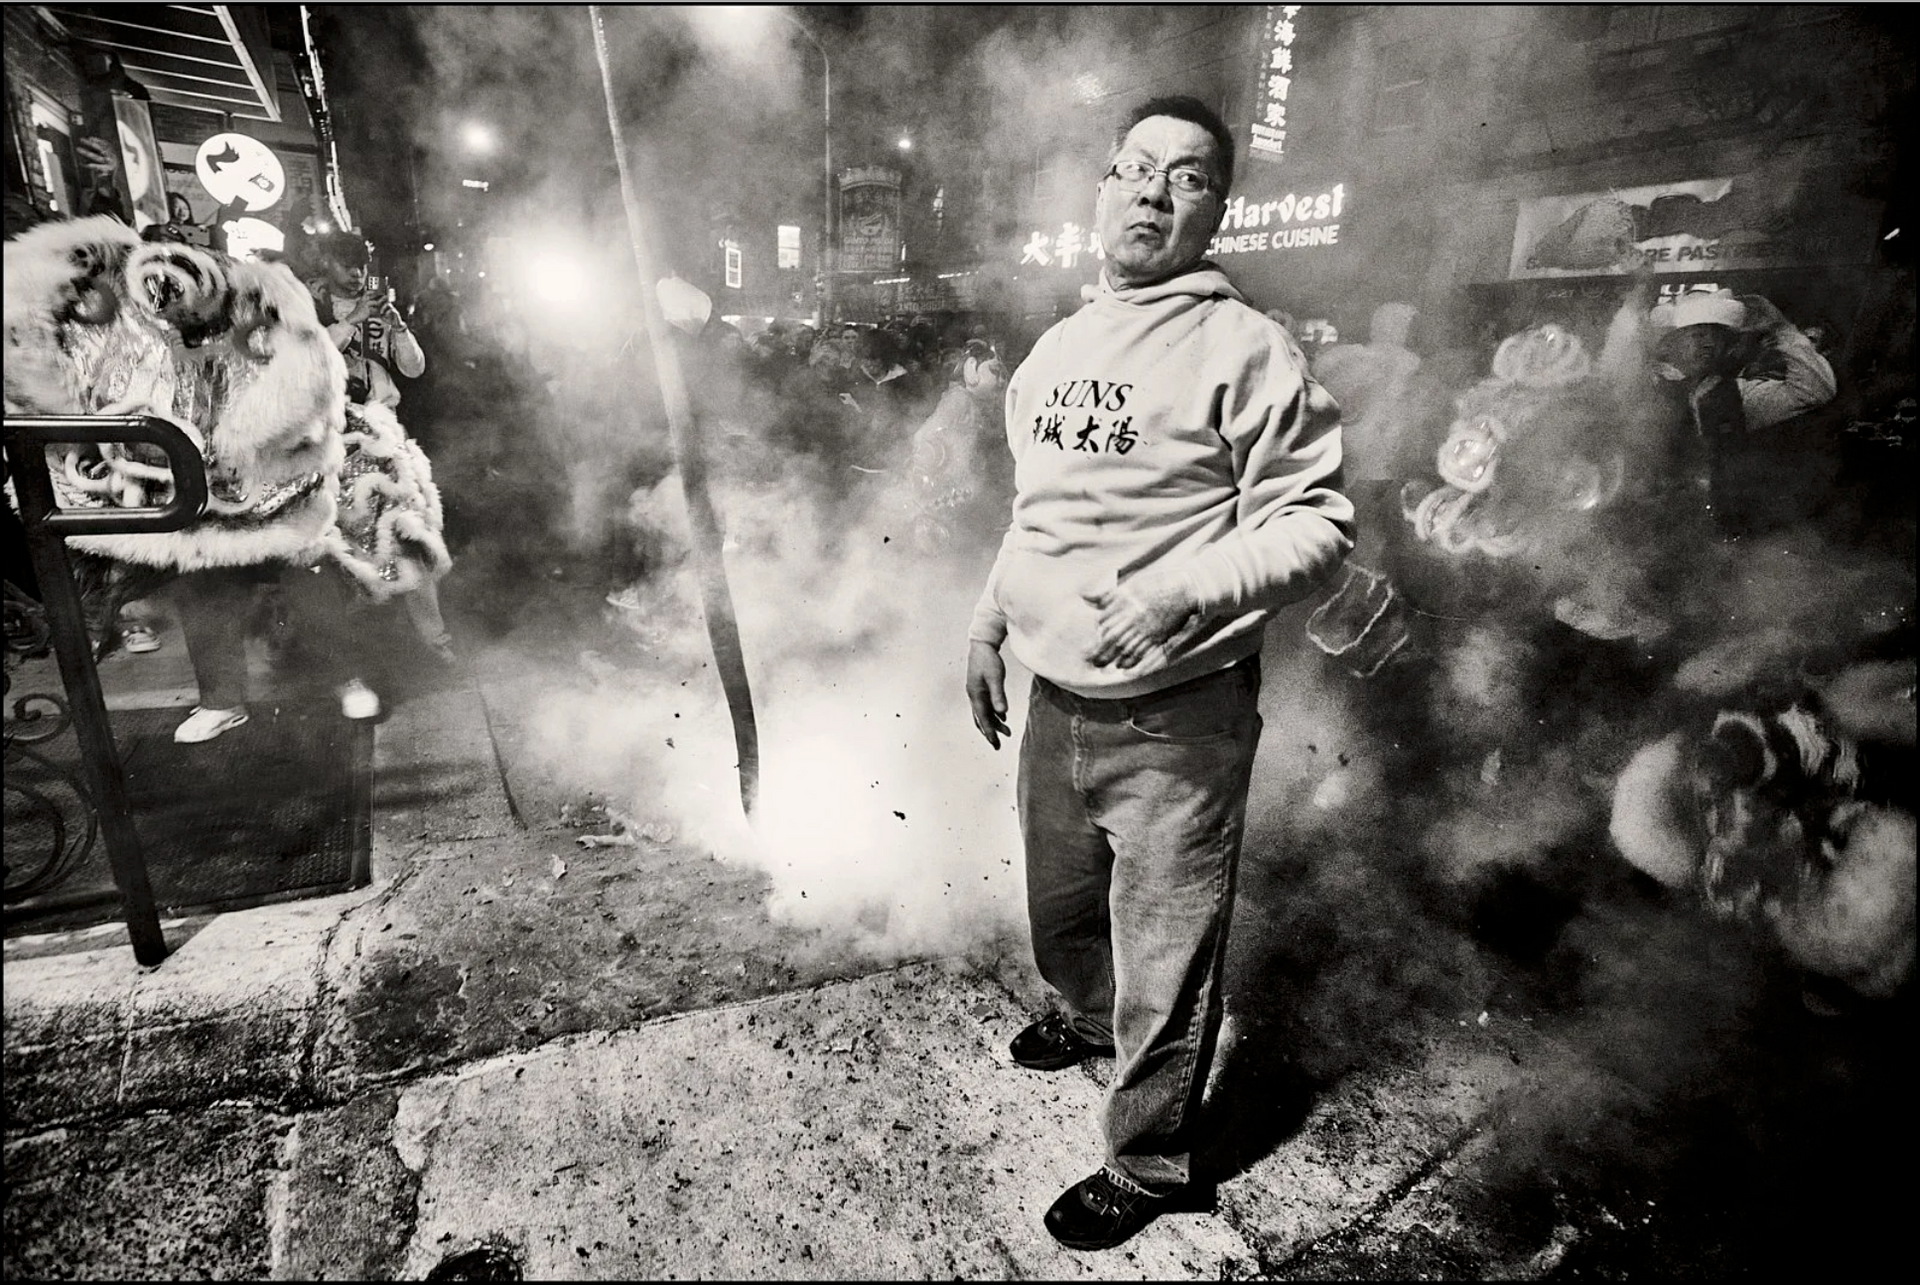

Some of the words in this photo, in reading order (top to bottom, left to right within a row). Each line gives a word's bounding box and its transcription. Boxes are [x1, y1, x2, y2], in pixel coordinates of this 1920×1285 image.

[1220, 183, 1345, 231] Harvest
[1271, 224, 1340, 249] CUISINE
[1045, 379, 1133, 411] SUNS
